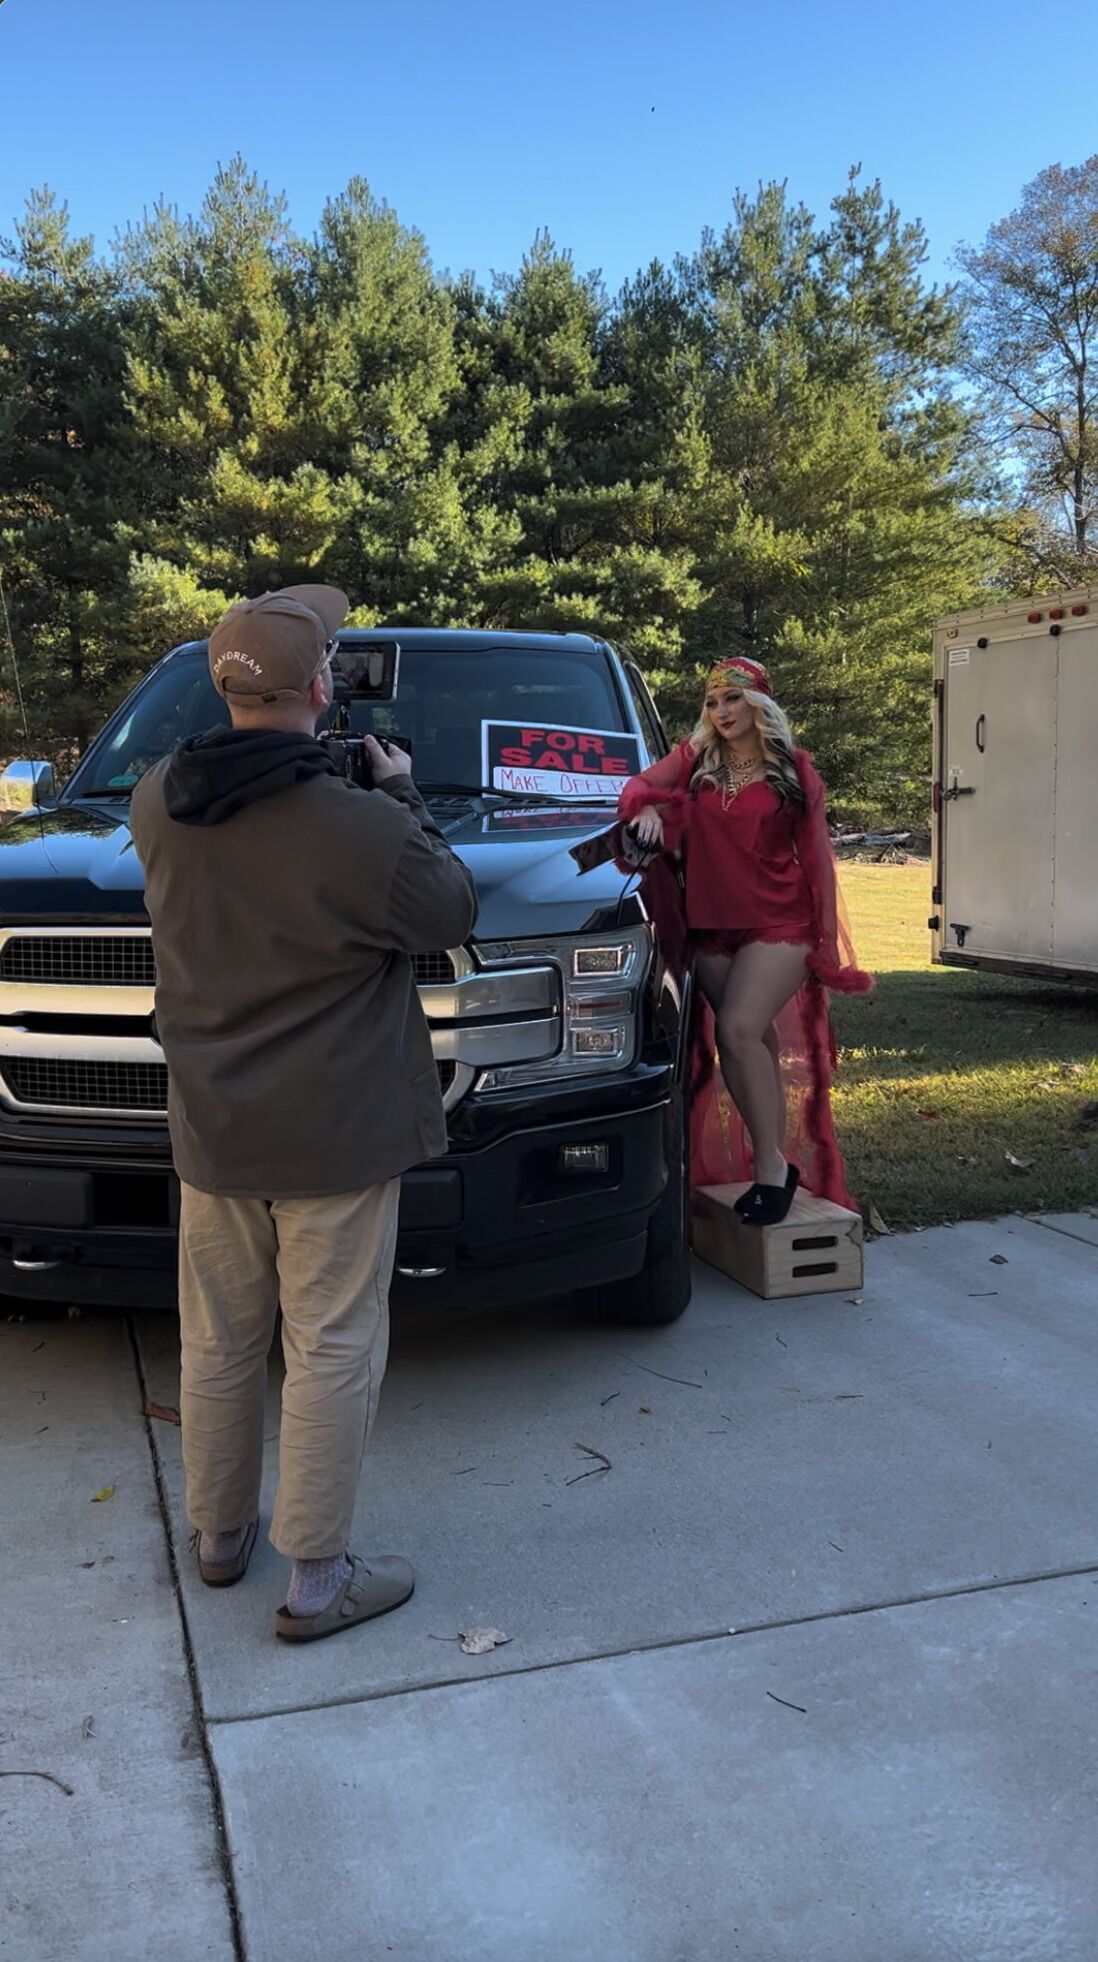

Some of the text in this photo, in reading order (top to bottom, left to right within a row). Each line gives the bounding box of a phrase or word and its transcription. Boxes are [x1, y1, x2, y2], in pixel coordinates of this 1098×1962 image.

[213, 651, 263, 676] DAYDREAM
[521, 730, 605, 754] FOR
[501, 747, 630, 775] SALE
[501, 769, 546, 791] MAKE
